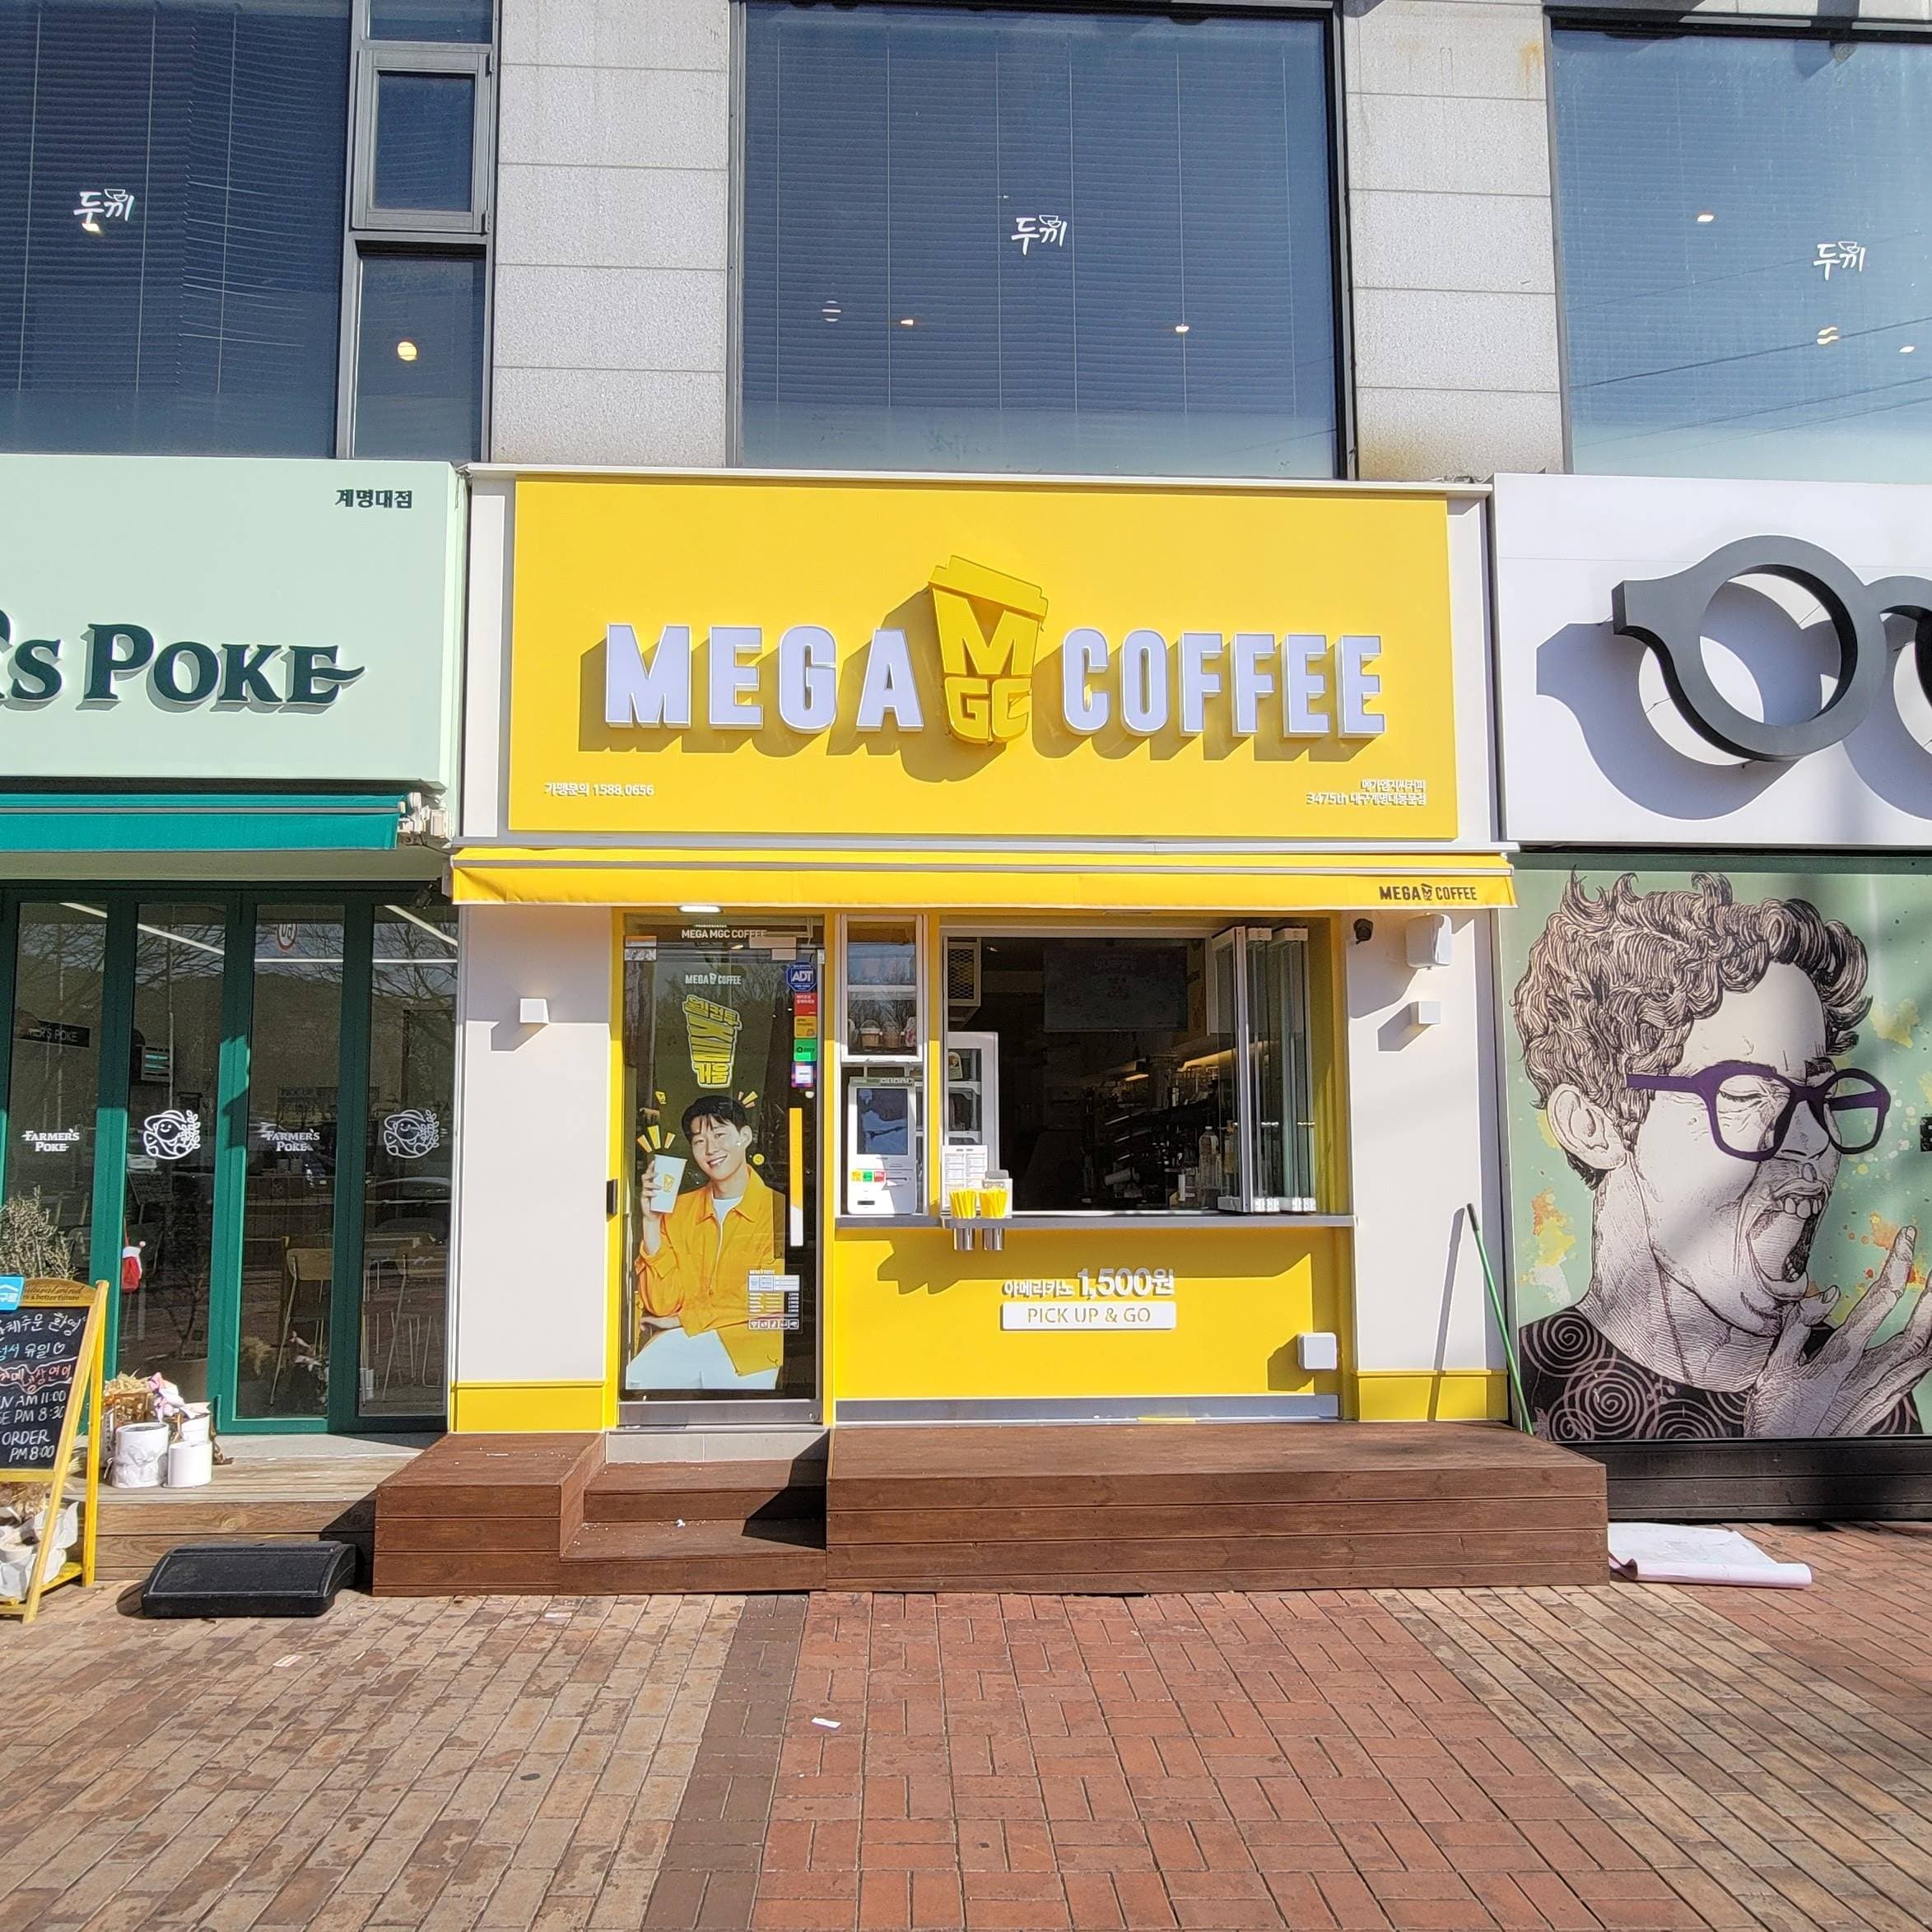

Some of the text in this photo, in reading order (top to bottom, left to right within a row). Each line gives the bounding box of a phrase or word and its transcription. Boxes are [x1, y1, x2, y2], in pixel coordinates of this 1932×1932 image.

[334, 489, 412, 509] 계명대점
[84, 623, 365, 705] POKE
[605, 623, 1387, 738] MEGA COFFEE
[544, 782, 589, 796] 가맹문의
[1306, 793, 1347, 804] 3475th
[1379, 886, 1478, 901] MEGA COFFEE
[681, 929, 768, 939] MEGA MGC COFFEE
[685, 974, 742, 985] MEGA COFFEE
[792, 971, 813, 982] ADT
[21, 1128, 80, 1141] FARMER'S
[262, 1129, 320, 1141] FARMER'S
[35, 1142, 69, 1152] POKE
[276, 1141, 310, 1152] POKE
[1003, 1268, 1175, 1300] 아메리카노 1,500원
[1027, 1307, 1151, 1323] PICK UP & GO
[15, 1394, 38, 1408] AM
[40, 1390, 67, 1404] 11:00
[14, 1408, 35, 1423] PM
[2, 1429, 51, 1446] ORDER
[8, 1447, 28, 1463] PM
